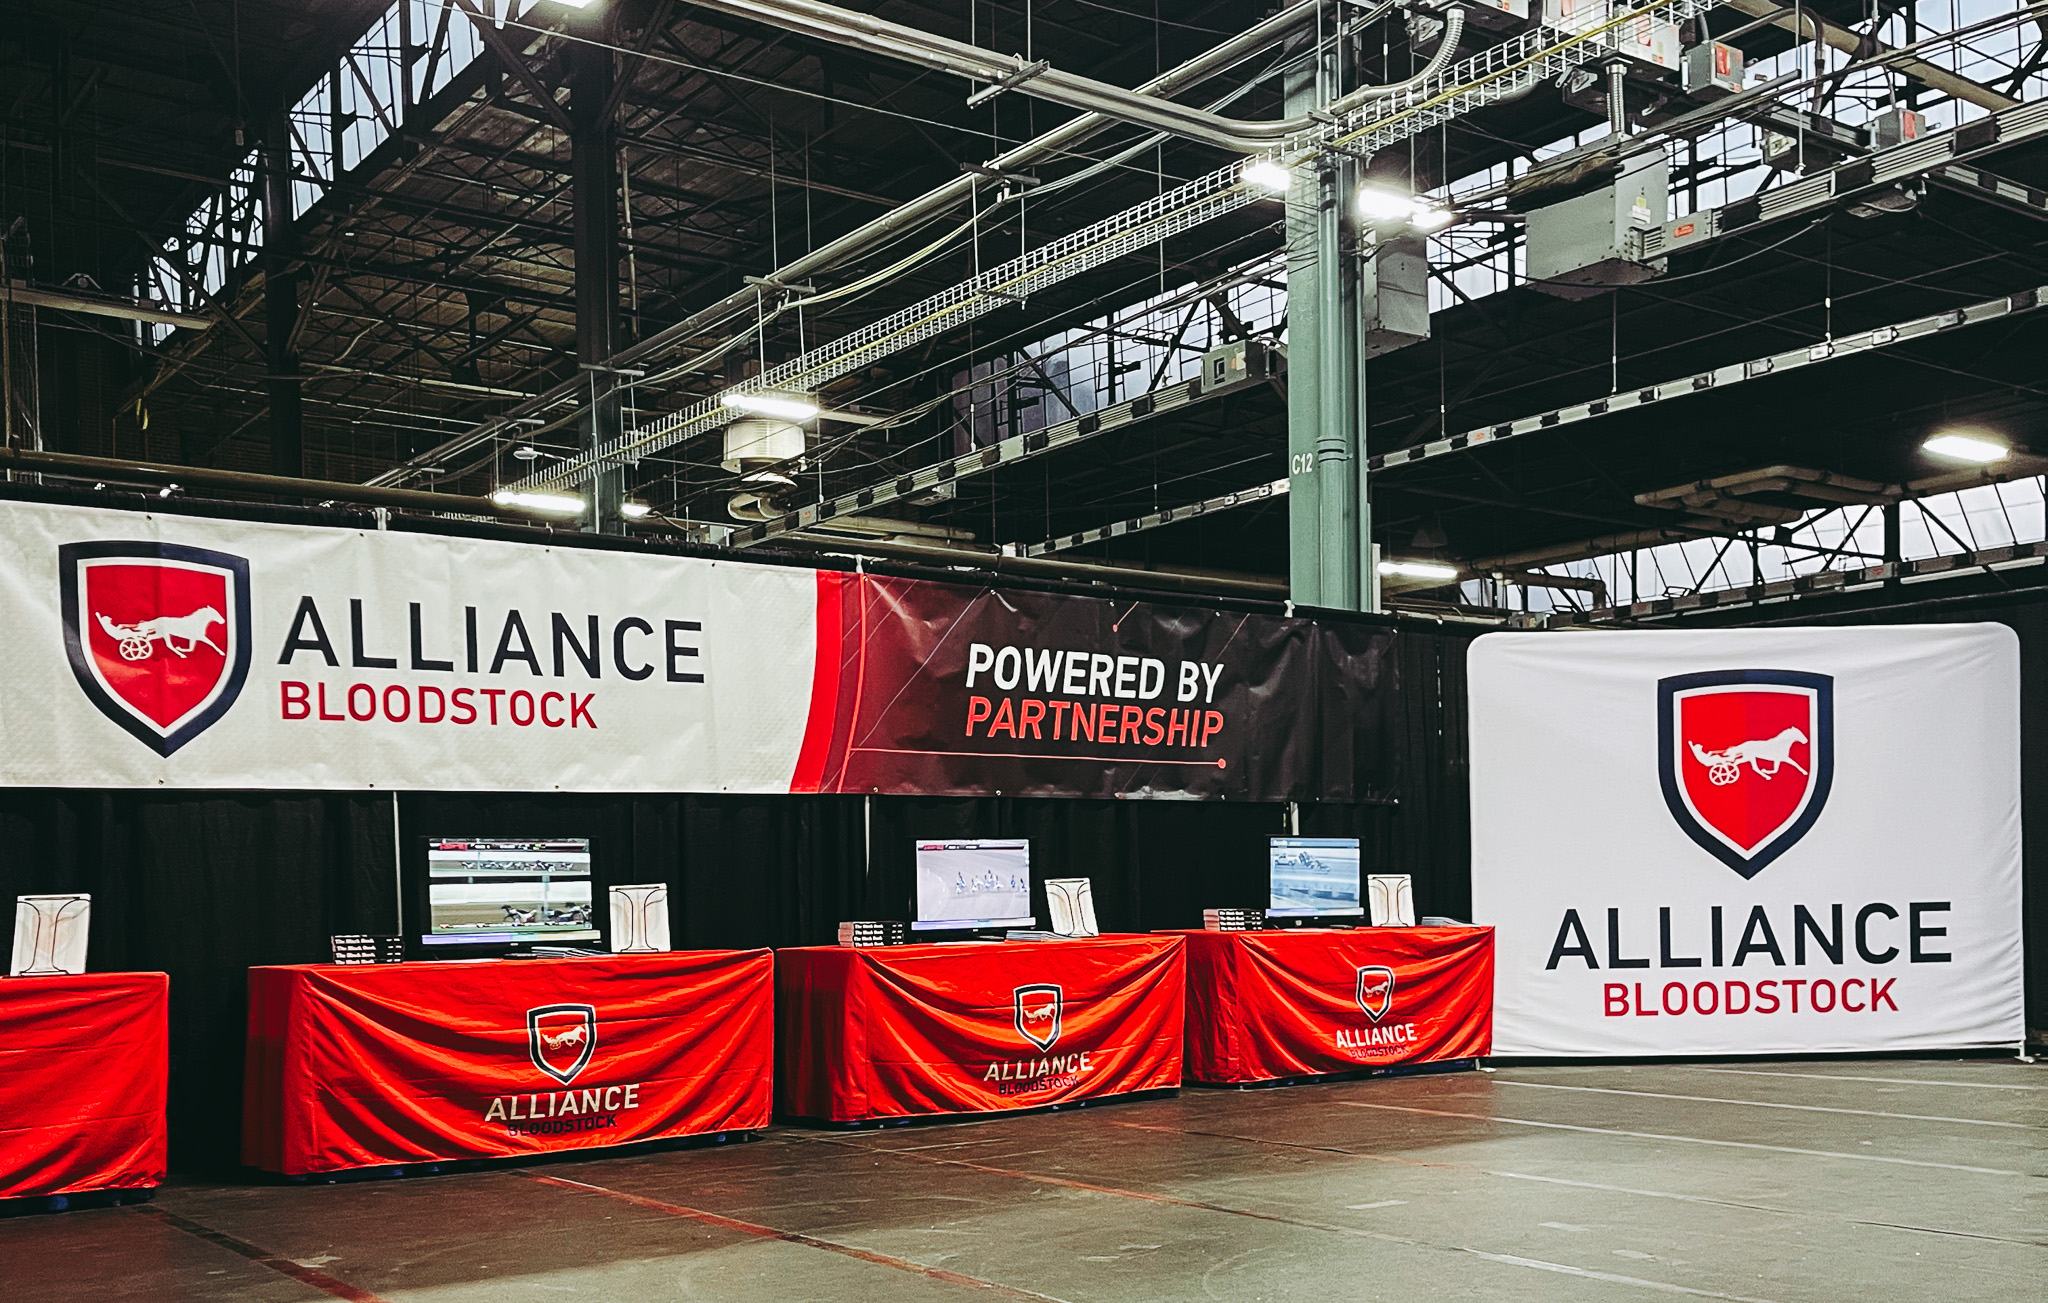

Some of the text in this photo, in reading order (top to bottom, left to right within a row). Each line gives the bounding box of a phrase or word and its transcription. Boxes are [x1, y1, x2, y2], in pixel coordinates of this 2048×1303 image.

[1292, 452, 1313, 475] C12
[277, 595, 705, 684] ALLIANCE
[965, 643, 1225, 703] POWERED BY
[280, 680, 599, 729] BLOODSTOCK
[965, 696, 1224, 747] PARTNERSHIP
[1545, 901, 1952, 971] ALLIANCE
[1603, 978, 1899, 1018] BLOODSTOCK
[1336, 1023, 1418, 1048] ALLIANCE
[983, 1051, 1095, 1081] ALLIANCE
[998, 1075, 1080, 1095] BLOODSTOCK
[484, 1083, 640, 1122] ALLIANCE
[507, 1113, 618, 1136] BLOODSTOCK
